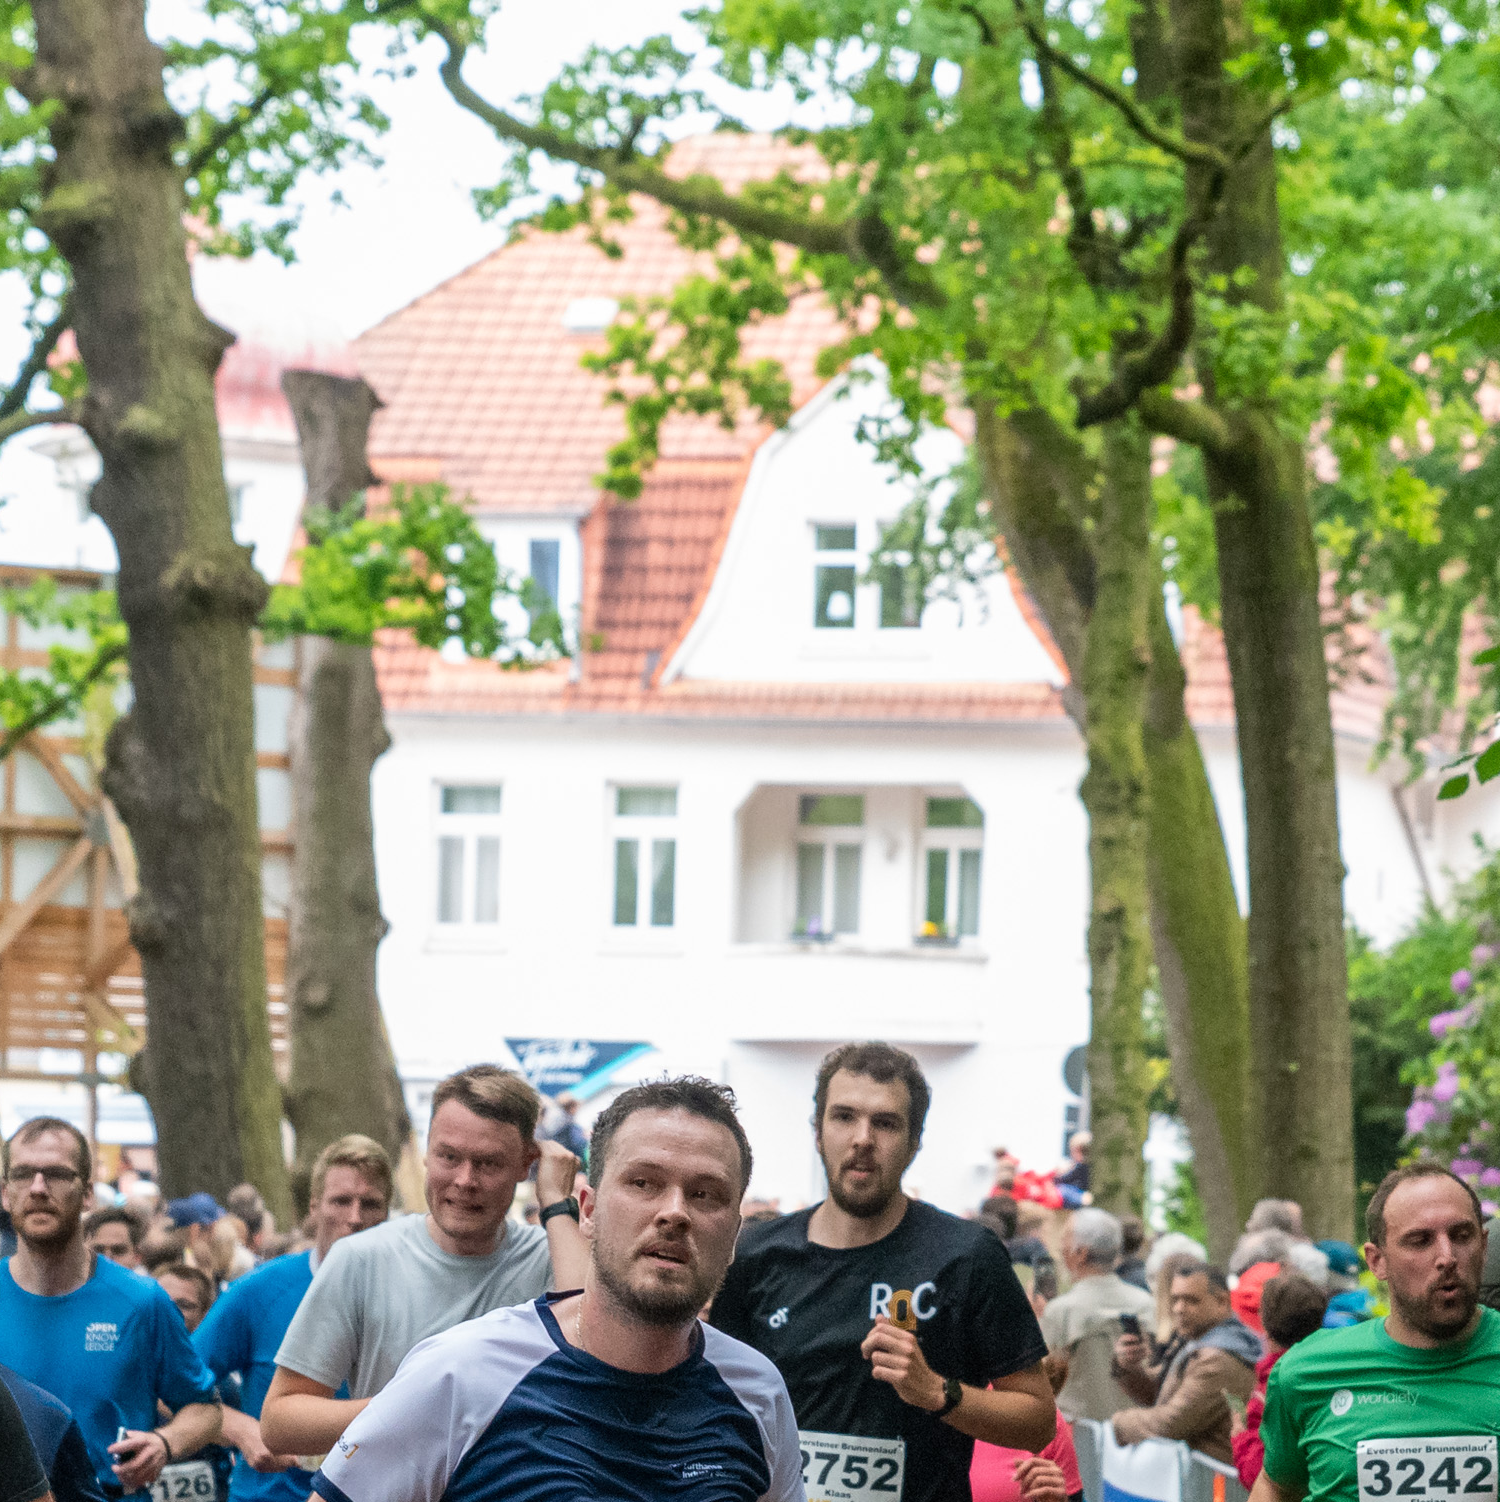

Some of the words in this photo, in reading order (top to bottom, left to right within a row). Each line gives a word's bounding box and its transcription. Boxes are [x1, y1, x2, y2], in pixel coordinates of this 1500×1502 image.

[86, 1333, 120, 1341] KNOW
[799, 1440, 839, 1449] erstener
[841, 1443, 897, 1455] Brunnenlauf
[1366, 1447, 1422, 1455] Everstener
[1425, 1444, 1488, 1453] Brunnenlauf
[1363, 1456, 1493, 1497] 3242
[825, 1489, 851, 1499] Klaas
